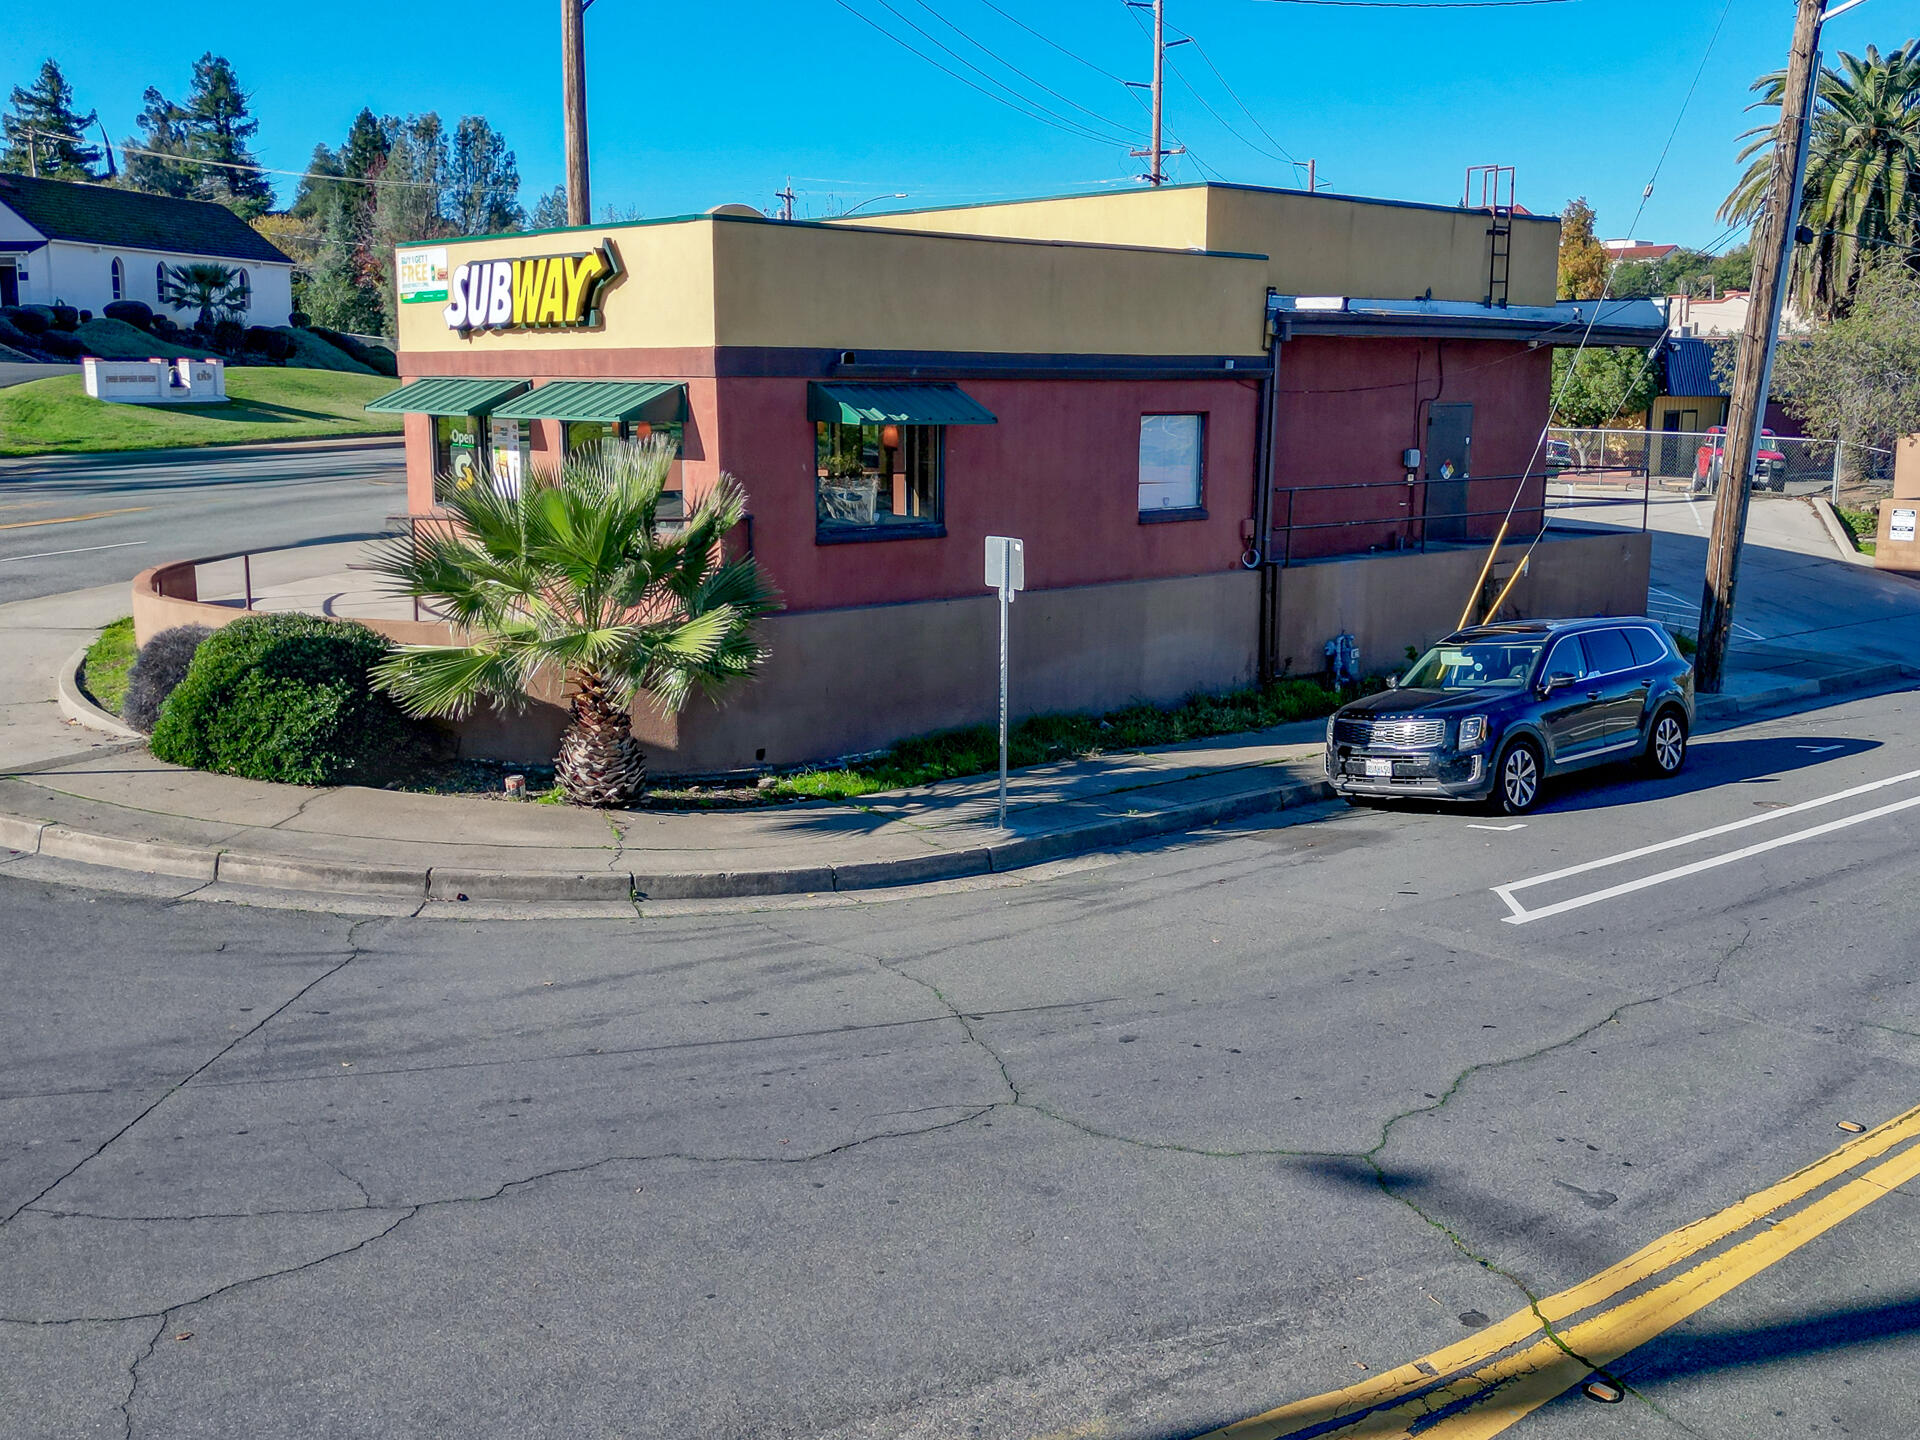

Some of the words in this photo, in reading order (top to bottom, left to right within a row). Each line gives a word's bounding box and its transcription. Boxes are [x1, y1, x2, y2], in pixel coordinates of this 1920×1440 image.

[415, 254, 425, 264] GET
[401, 264, 428, 281] FREE
[443, 252, 602, 327] SUBWAY
[451, 429, 475, 446] Open
